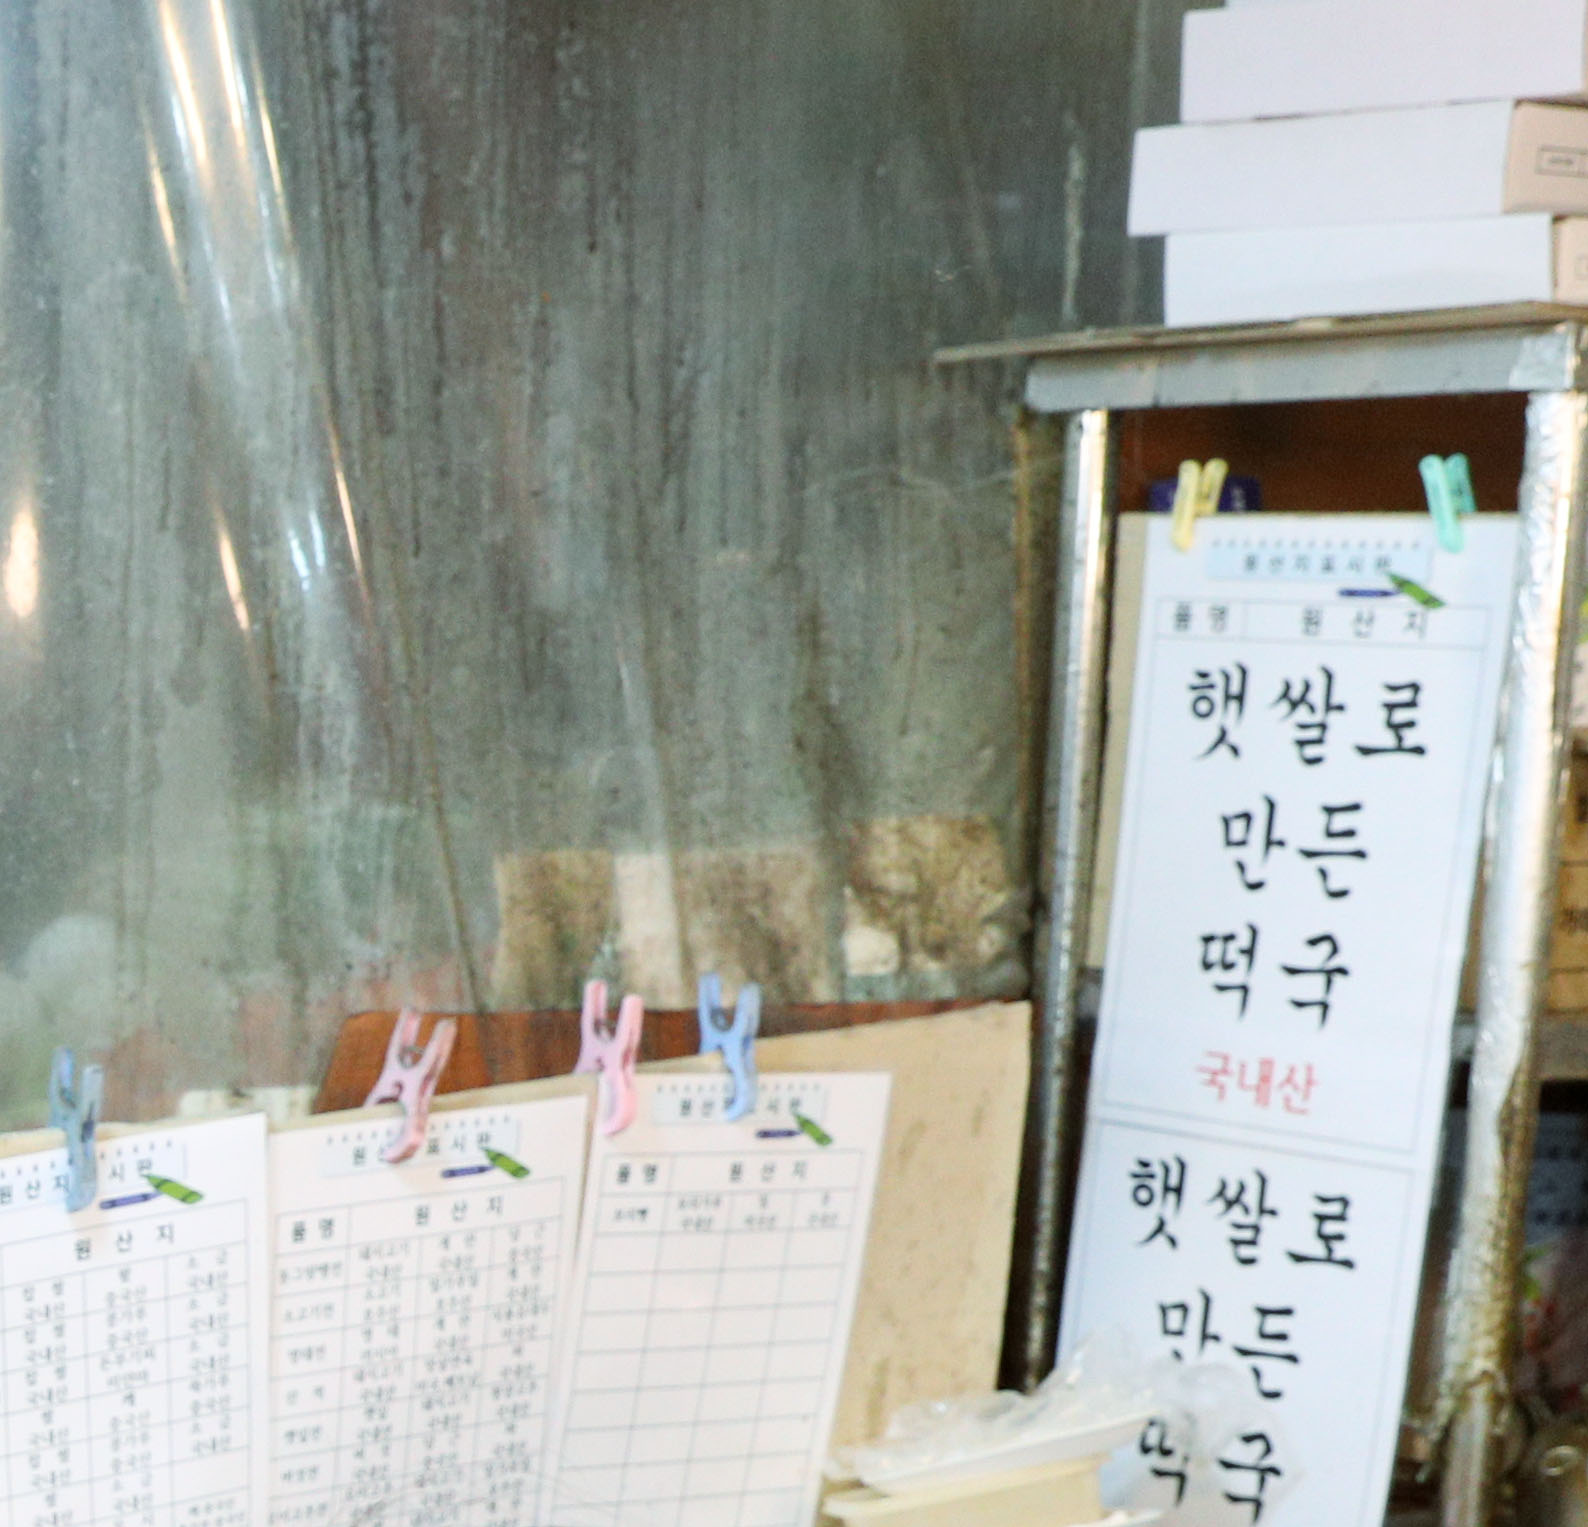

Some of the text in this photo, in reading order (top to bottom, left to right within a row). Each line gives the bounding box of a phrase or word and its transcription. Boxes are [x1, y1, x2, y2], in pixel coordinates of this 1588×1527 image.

[1187, 662, 1429, 767] 햇쌀로
[1220, 793, 1370, 901] 만든
[1199, 924, 1352, 1031] 떡국
[1194, 1050, 1319, 1116] 국내산
[74, 1222, 175, 1262] 원산지
[1128, 1154, 1358, 1272] 햇쌀로
[1157, 1287, 1302, 1401] 만든
